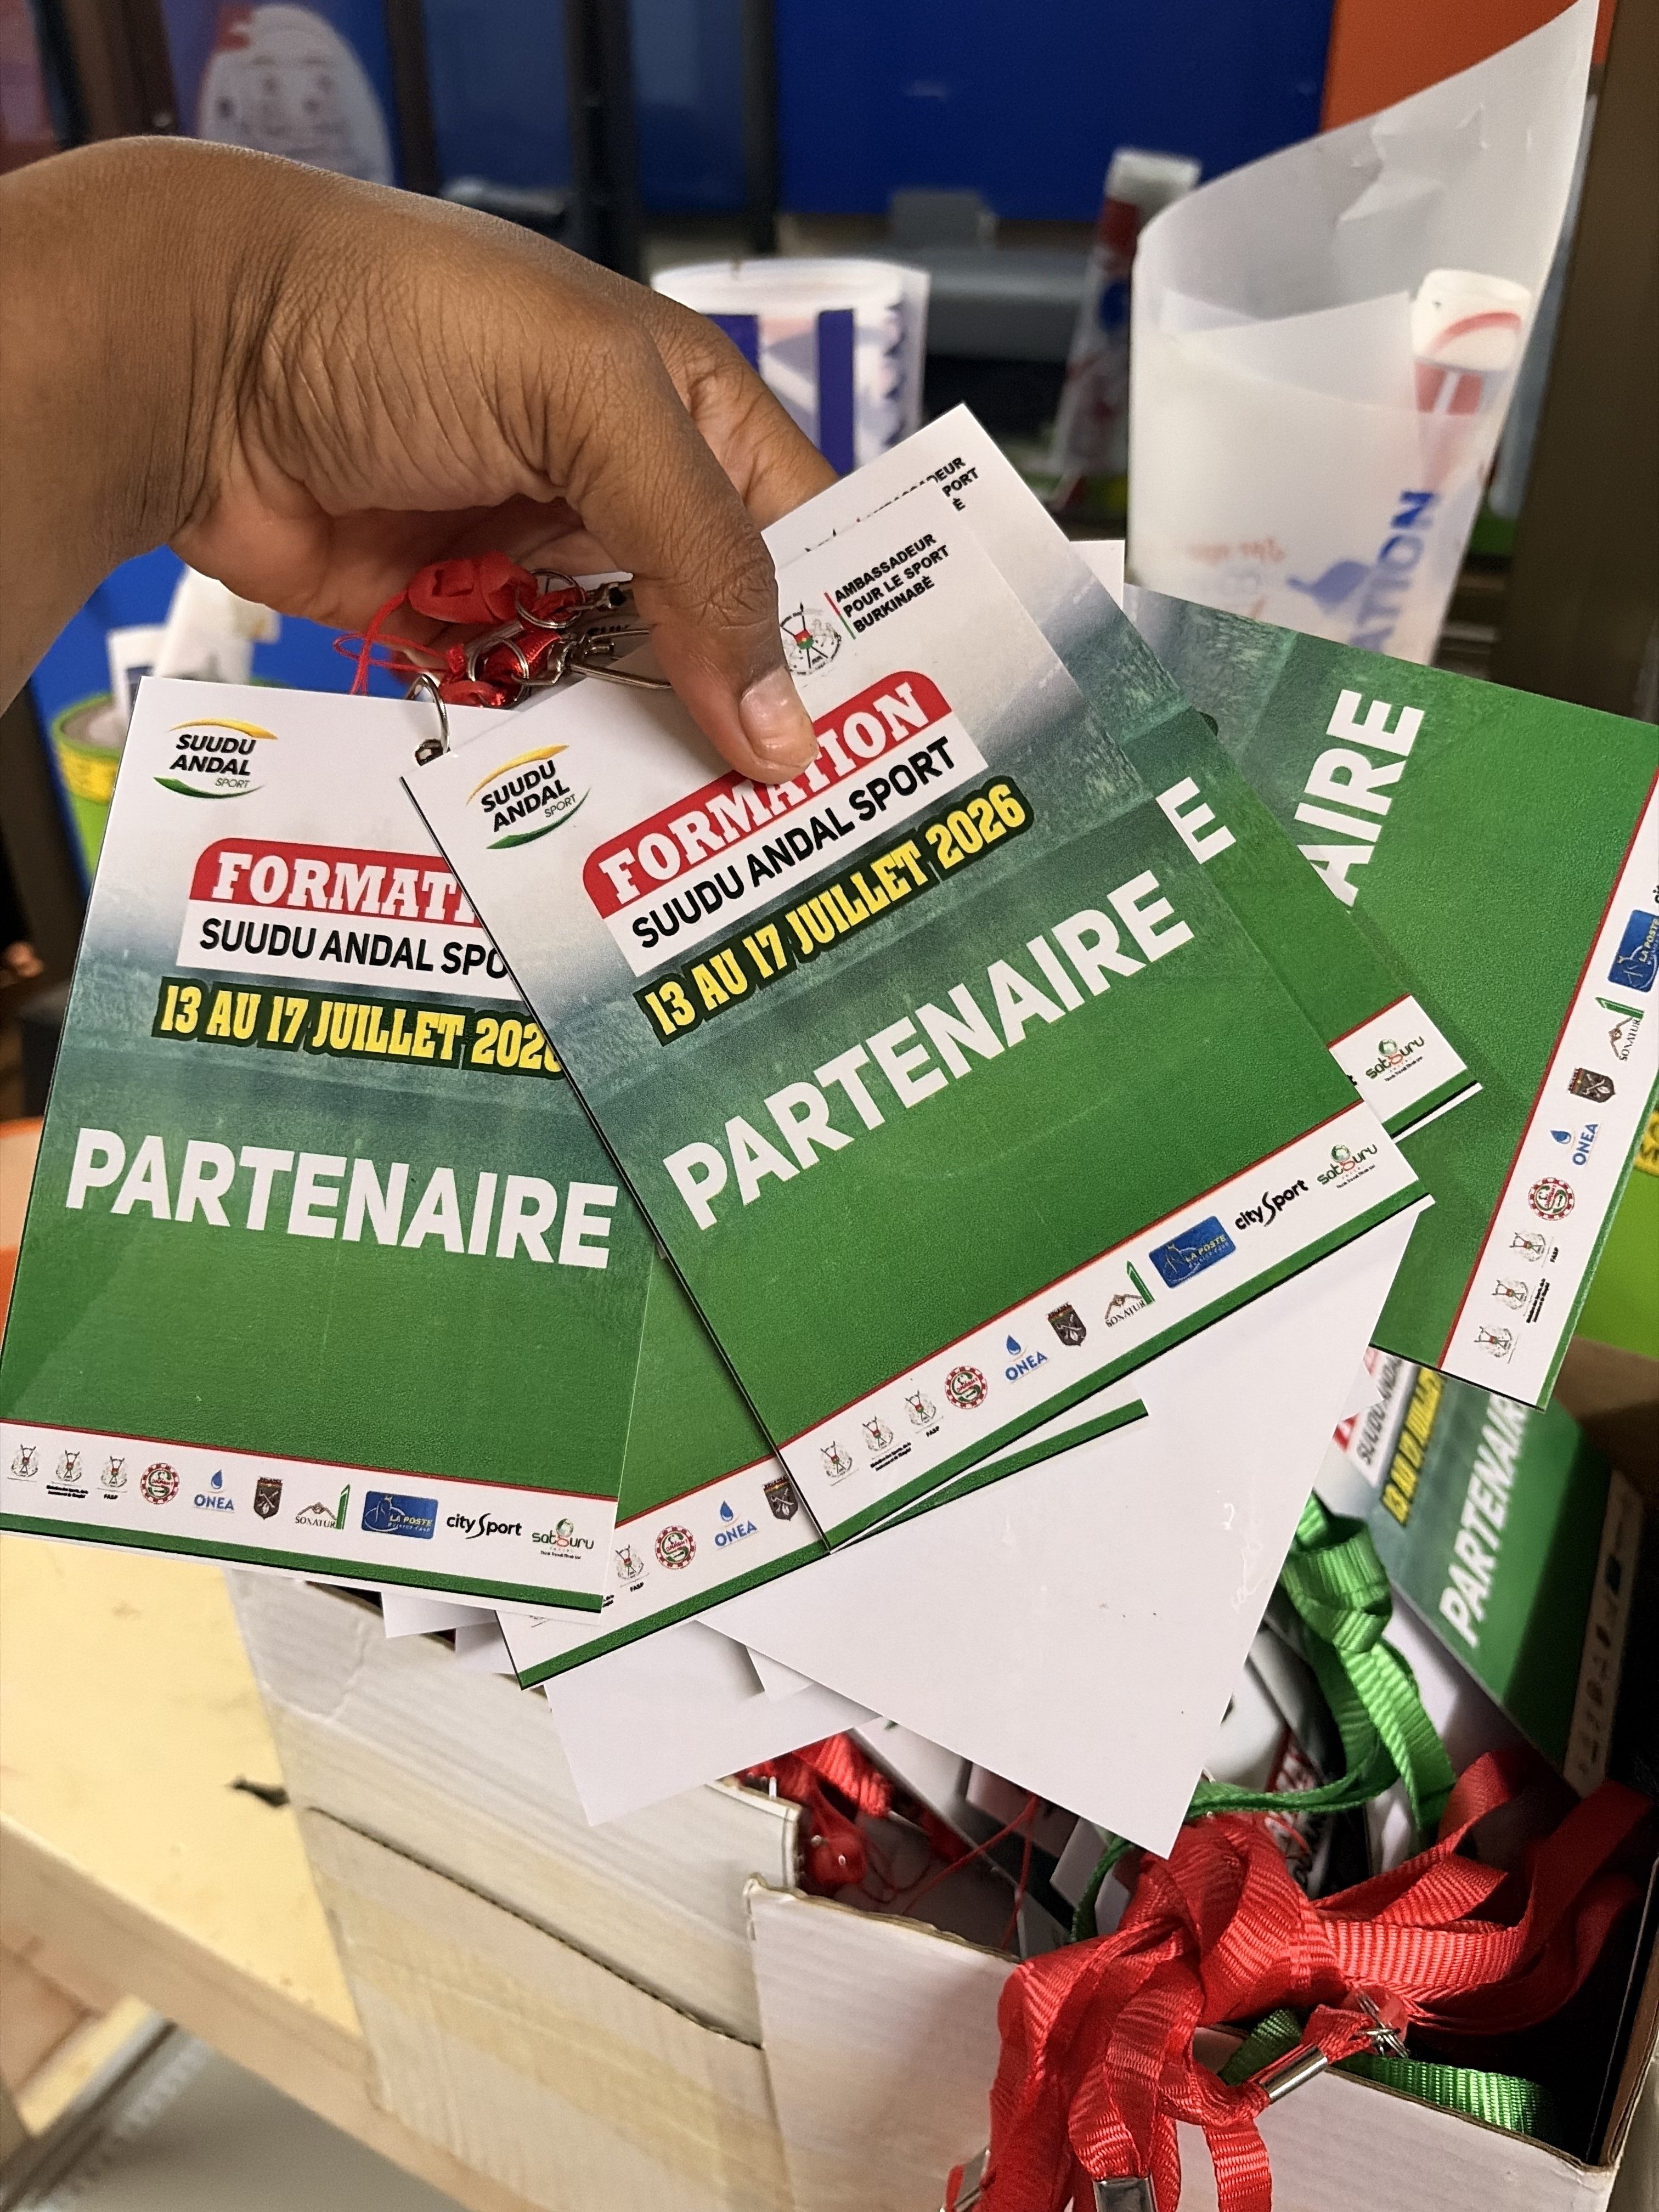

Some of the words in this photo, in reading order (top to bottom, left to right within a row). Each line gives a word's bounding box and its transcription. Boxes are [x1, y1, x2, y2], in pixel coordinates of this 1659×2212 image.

[942, 467, 979, 497] PORT
[834, 534, 937, 603] AMBASSADEUR
[843, 587, 885, 618] POUR
[883, 574, 904, 593] LE
[904, 544, 949, 579] SPORT
[169, 754, 251, 776] ANDAL
[176, 734, 257, 755] SUUDU
[215, 777, 251, 789] SPORT
[481, 760, 556, 813] SUUDU
[494, 779, 571, 833] ANDAL
[544, 794, 577, 818] SPORT
[631, 865, 745, 949] SUUDU
[746, 808, 855, 888] ANDAL
[849, 736, 956, 822] SPORT
[211, 851, 477, 924] FORMATI
[645, 980, 696, 1037] 13
[690, 946, 749, 1015] AU
[743, 924, 787, 981] 17
[785, 840, 928, 955] JUILLET
[925, 783, 1026, 871] 2026
[199, 917, 317, 960] SUUDU
[319, 929, 435, 972] ANDAL
[441, 941, 509, 979] SPO
[160, 985, 201, 1035] 13
[206, 990, 262, 1040] AU
[266, 996, 309, 1045] 17
[312, 1000, 466, 1061] JUILLET
[663, 868, 1195, 1231] PARTENAIRE
[1572, 1122, 1599, 1166] ONEA
[65, 1127, 619, 1269] PARTENAIRE
[1184, 1252, 1198, 1263] LA
[1198, 1234, 1227, 1255] POSTE
[1005, 1351, 1048, 1381] ONEA
[194, 1493, 235, 1511] ONEA
[295, 1516, 336, 1529] SONATUR
[389, 1514, 402, 1523] LA
[403, 1516, 433, 1527] POSTE
[1438, 1393, 1530, 1647] PARTENAIR
[532, 1530, 595, 1550] satguru
[714, 1520, 758, 1548] ONEA
